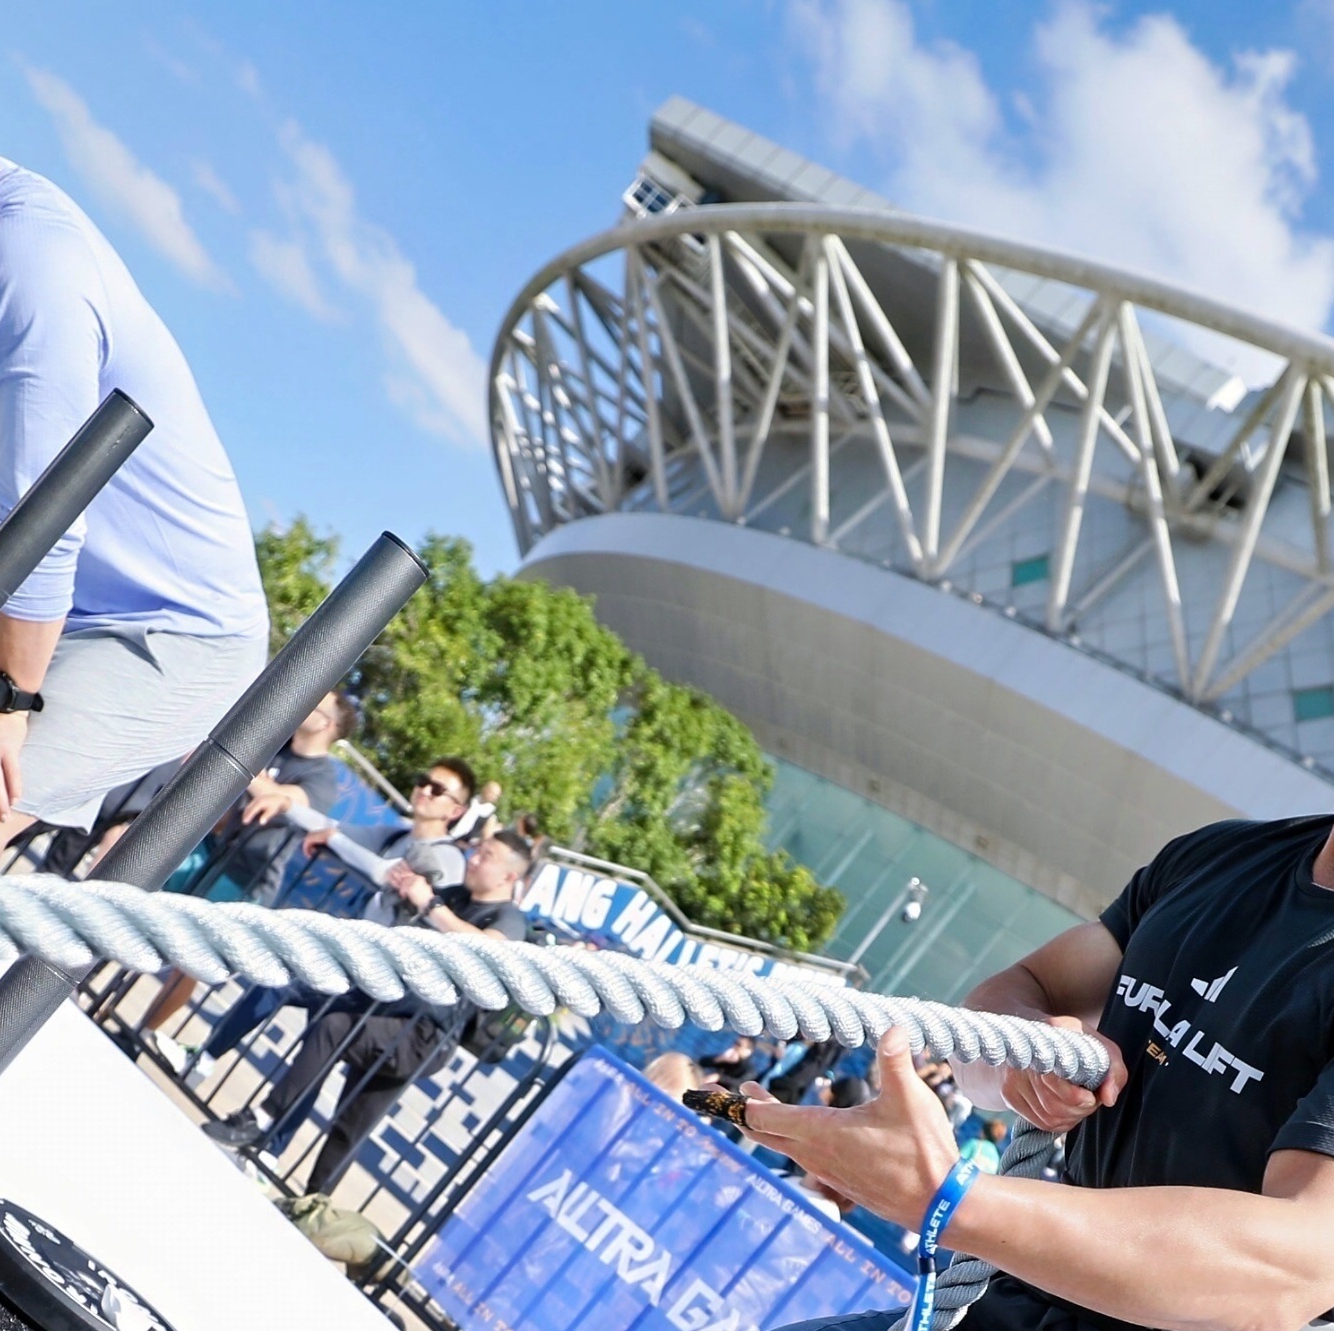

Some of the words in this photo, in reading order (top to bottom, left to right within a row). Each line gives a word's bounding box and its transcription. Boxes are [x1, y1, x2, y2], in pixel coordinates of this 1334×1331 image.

[924, 1197, 951, 1256] ATHLETE
[826, 1231, 857, 1263] ALL
[860, 1261, 886, 1285] IN
[884, 1279, 912, 1303] TO
